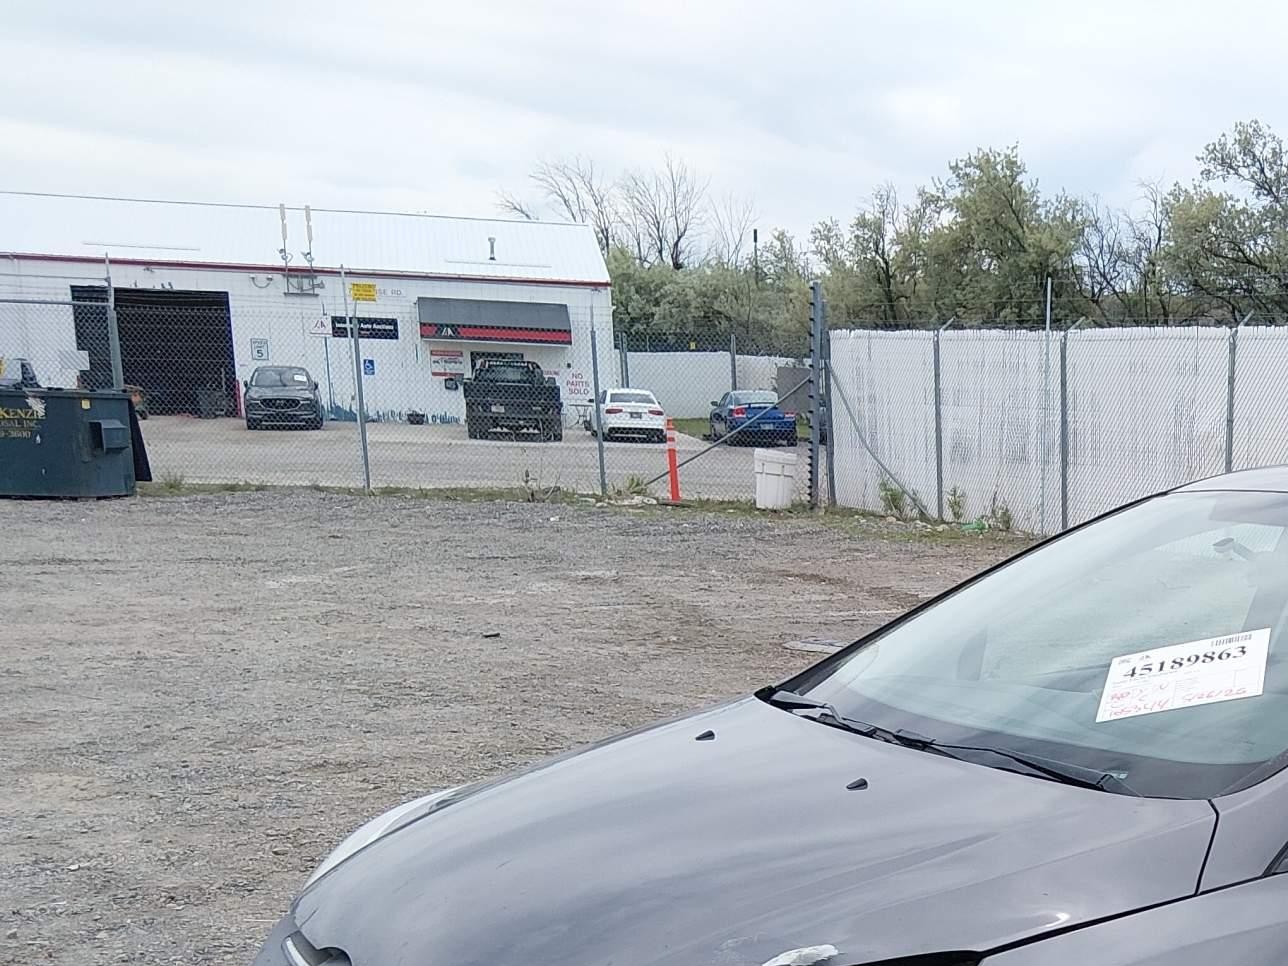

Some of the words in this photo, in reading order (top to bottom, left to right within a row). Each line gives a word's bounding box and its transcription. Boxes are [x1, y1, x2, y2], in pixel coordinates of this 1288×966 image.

[256, 349, 264, 358] 5
[571, 372, 584, 380] NO
[1123, 645, 1247, 678] 45189863
